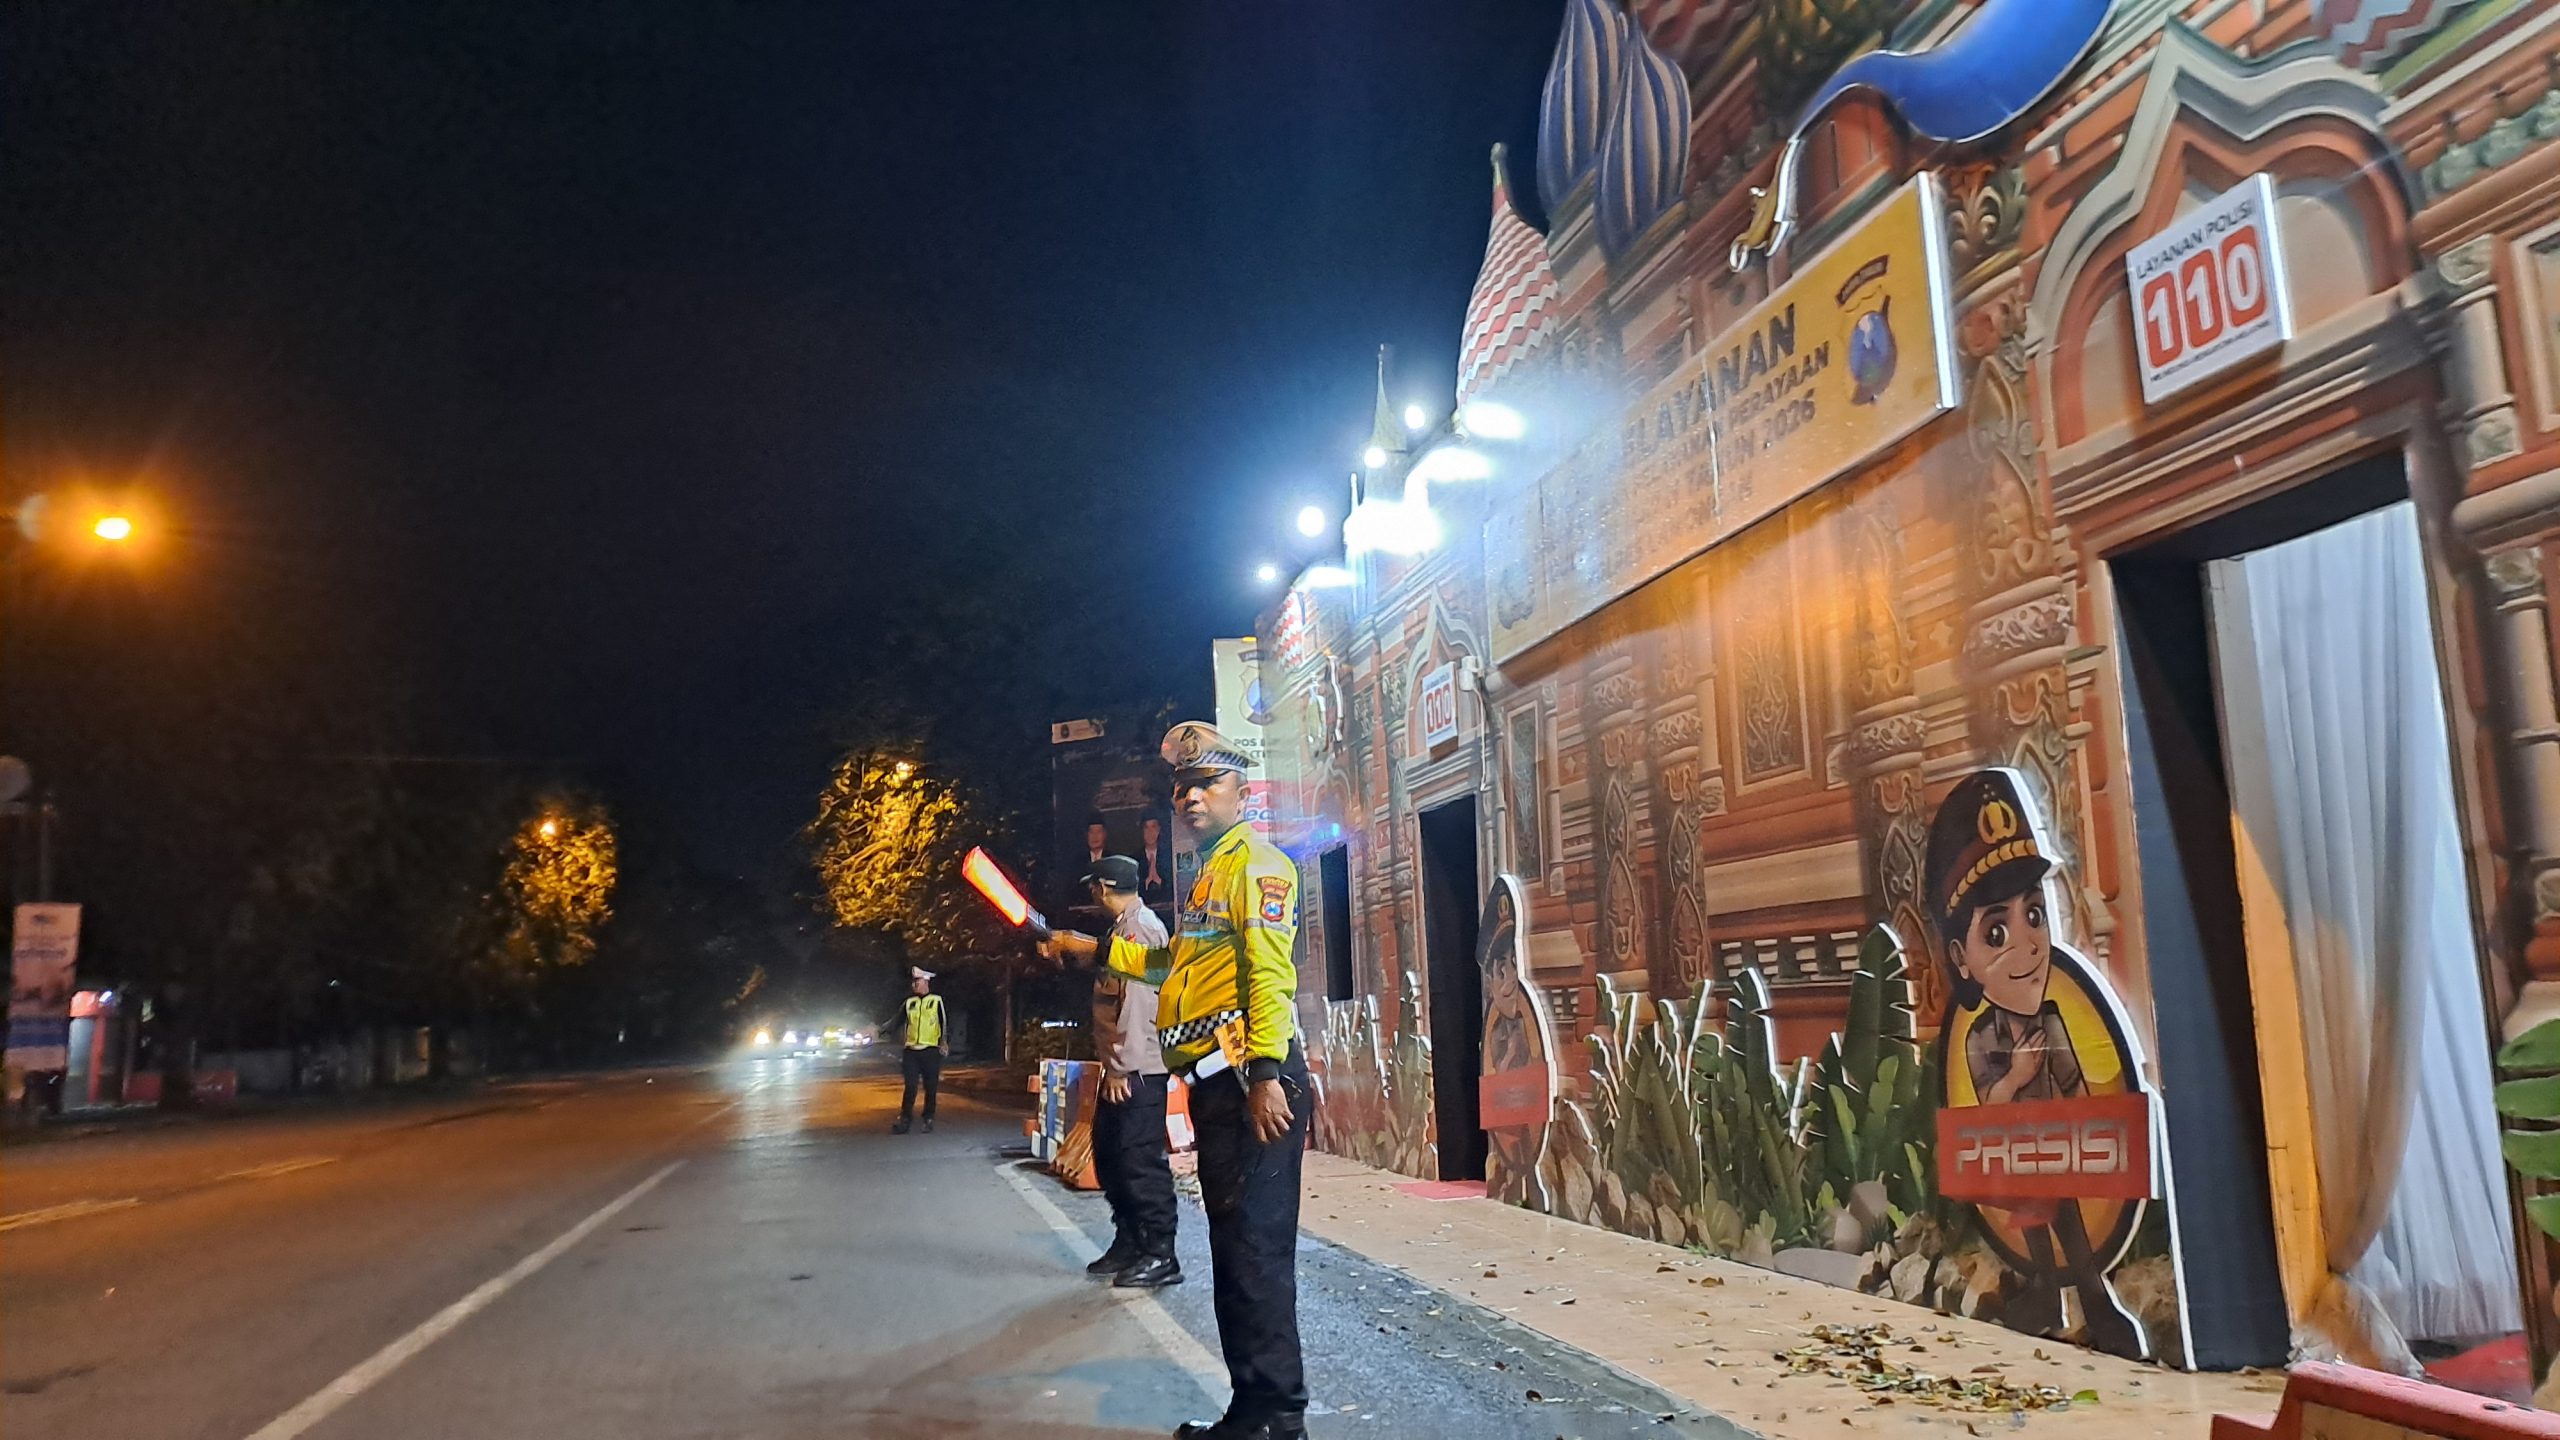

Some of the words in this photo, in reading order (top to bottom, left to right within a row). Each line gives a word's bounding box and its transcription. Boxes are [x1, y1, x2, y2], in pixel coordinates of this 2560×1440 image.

[2136, 228, 2204, 279] LAYANAN
[2205, 198, 2256, 240] POLISI
[2146, 242, 2262, 355] 110
[1727, 339, 1831, 430] PERAYAAN
[1761, 386, 1817, 449] 2026
[1427, 688, 1451, 728] 110
[1955, 1119, 2129, 1176] PRESISI
